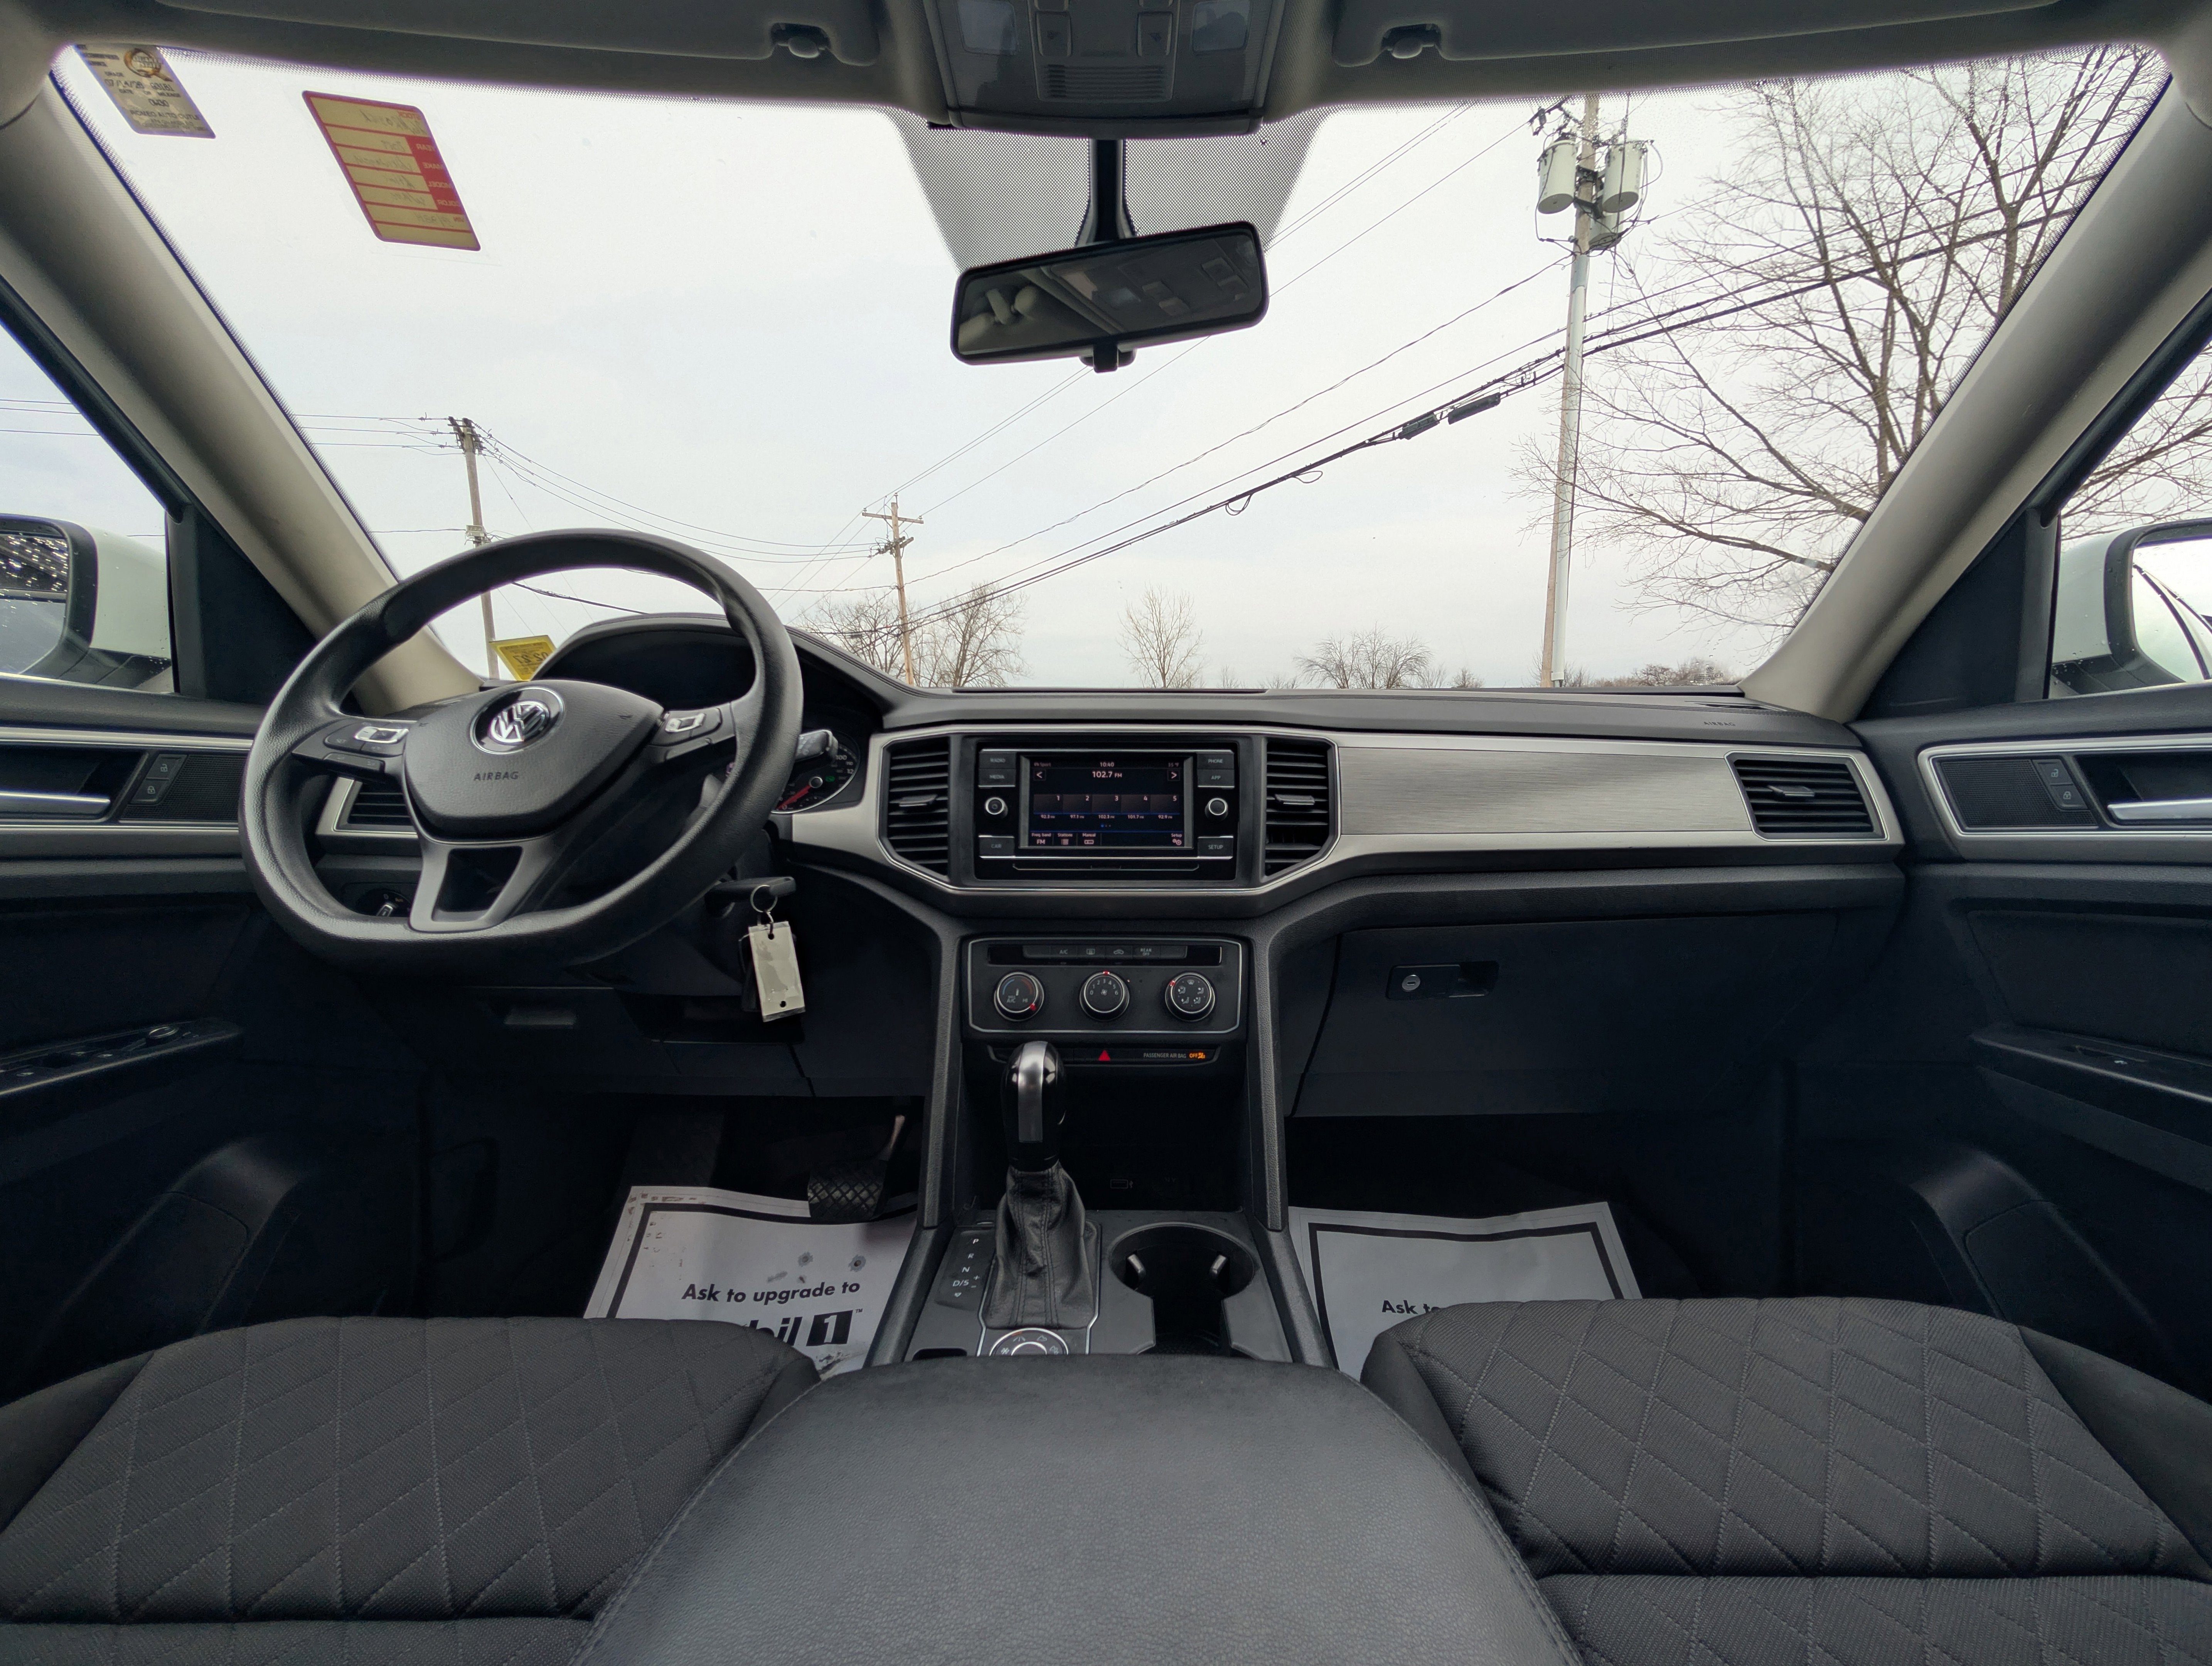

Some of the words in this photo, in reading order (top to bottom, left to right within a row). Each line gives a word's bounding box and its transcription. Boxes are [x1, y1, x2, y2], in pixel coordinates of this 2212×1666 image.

[473, 772, 519, 781] AIRBAG
[681, 1283, 721, 1302] Ask
[726, 1289, 746, 1302] to
[753, 1282, 835, 1305] upgrade
[842, 1282, 860, 1293] to
[1382, 1300, 1419, 1314] Ask
